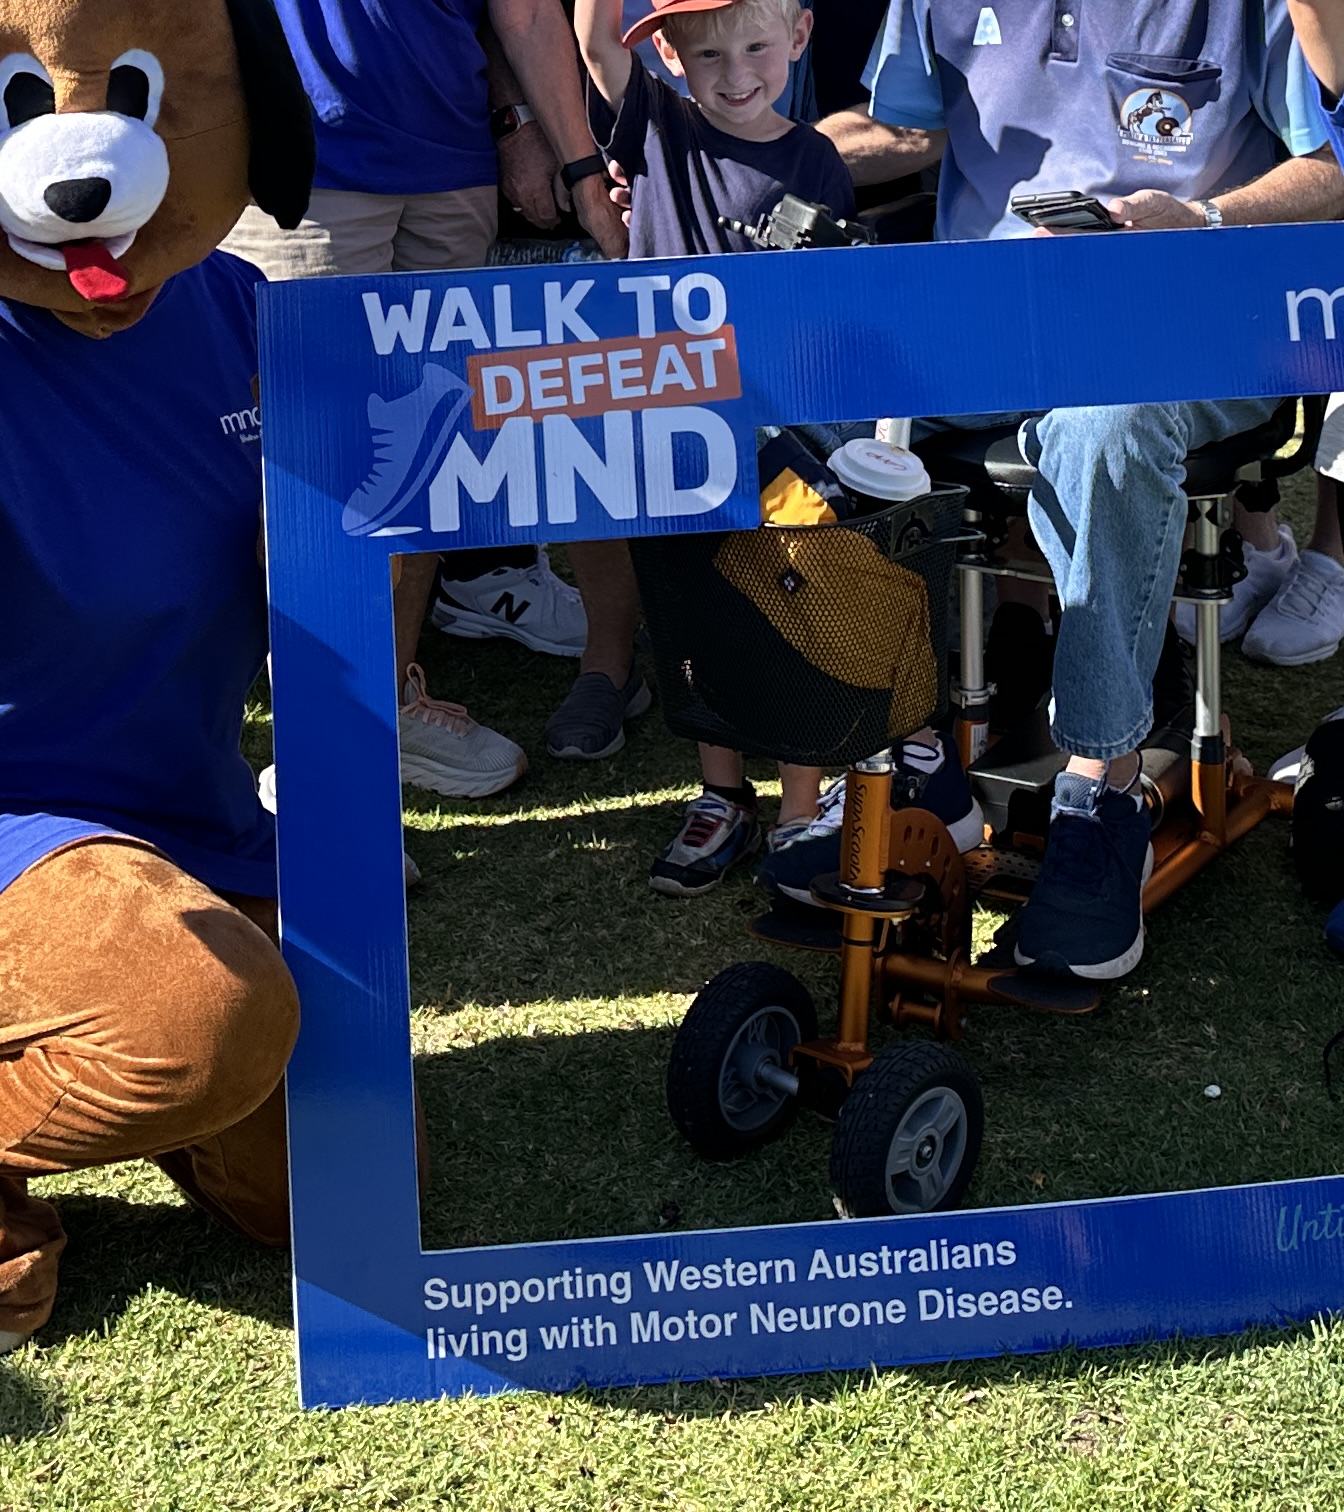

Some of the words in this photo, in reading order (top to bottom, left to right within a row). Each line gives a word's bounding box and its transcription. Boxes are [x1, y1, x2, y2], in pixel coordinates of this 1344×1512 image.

[362, 279, 598, 356] WALK
[618, 272, 727, 339] TO
[481, 338, 726, 416] DEFEAT
[429, 406, 738, 533] MND
[423, 1266, 632, 1315] Supporting
[643, 1250, 797, 1293] Western
[807, 1239, 1017, 1281] Australians
[426, 1325, 529, 1362] living
[538, 1312, 618, 1352] with
[630, 1306, 739, 1344] Motor
[750, 1294, 908, 1336] Neurone
[918, 1282, 1074, 1324] Disease.
